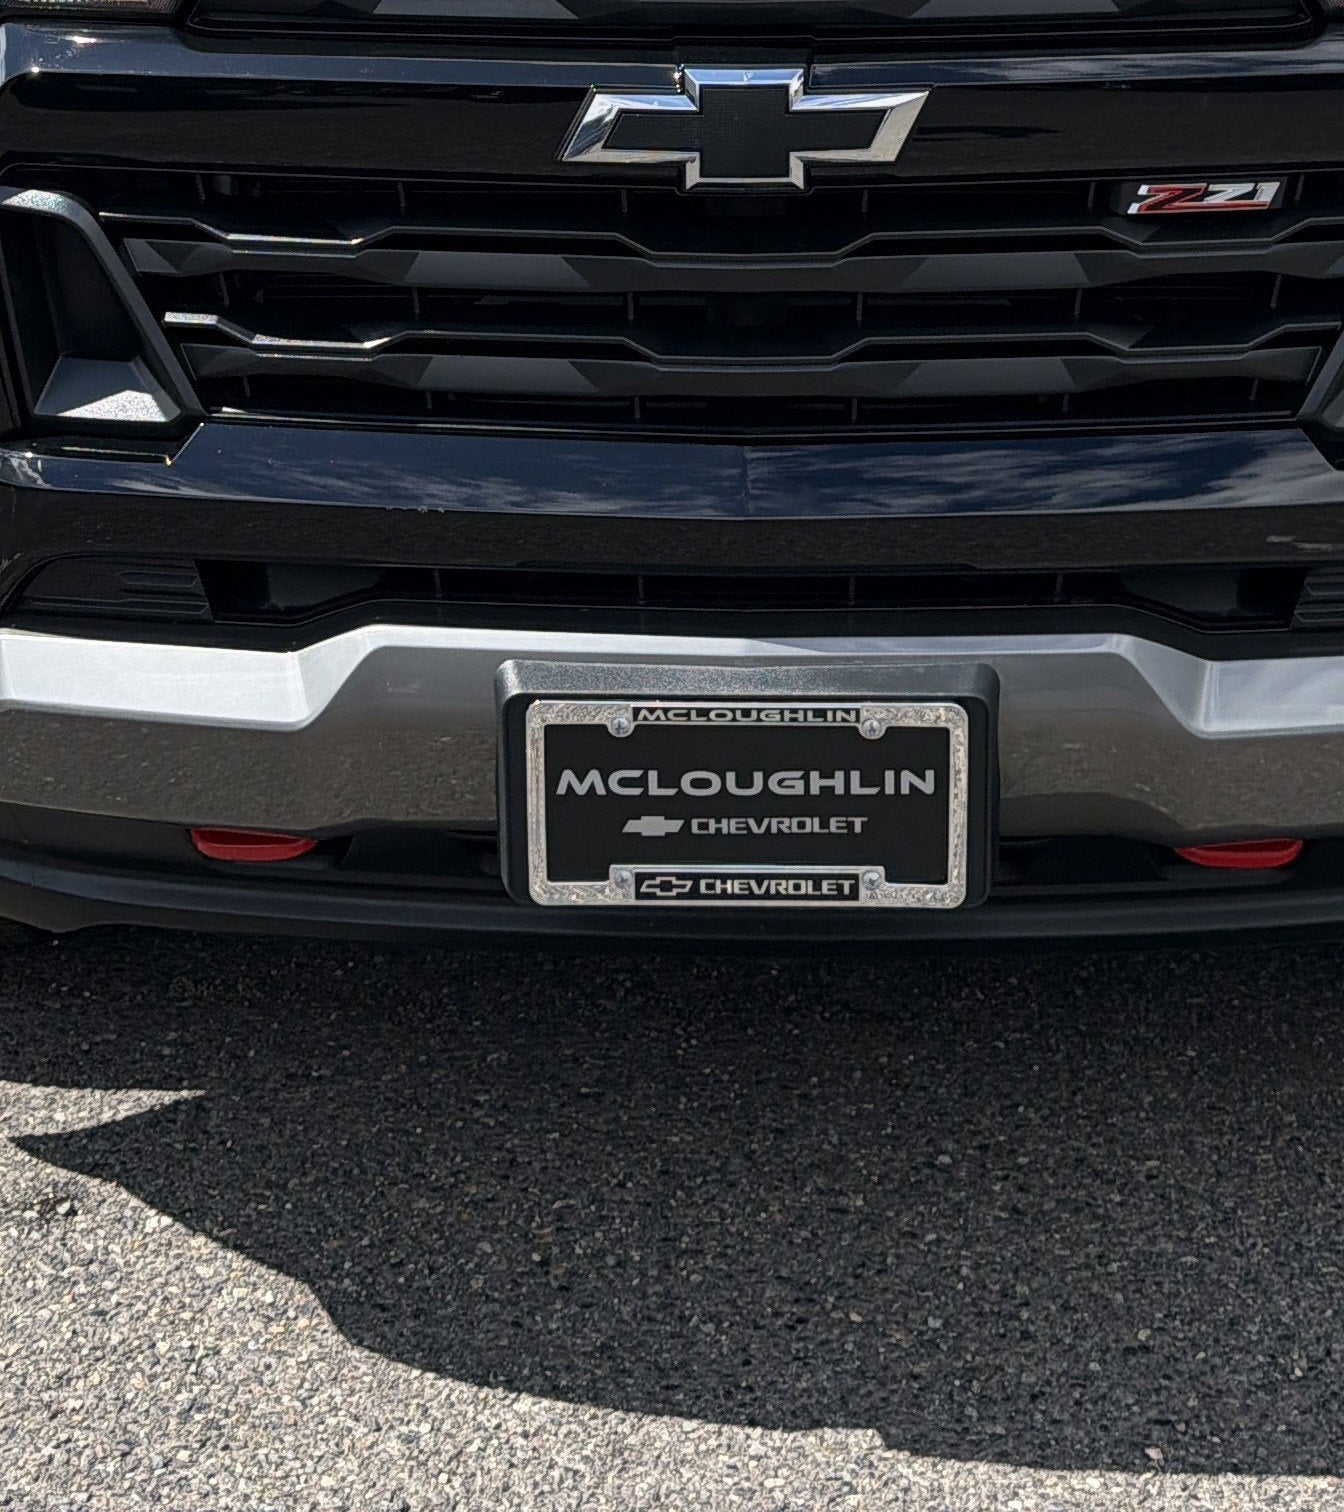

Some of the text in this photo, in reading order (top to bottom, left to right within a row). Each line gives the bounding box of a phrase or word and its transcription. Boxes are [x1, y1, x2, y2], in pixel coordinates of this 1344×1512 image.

[1127, 182, 1281, 214] Z71
[637, 708, 856, 723] MCLOUGHLIN
[556, 769, 935, 796] MCLOUGHLIN
[691, 816, 868, 835] CHEVROLET
[699, 878, 856, 896] CHEVROLET
